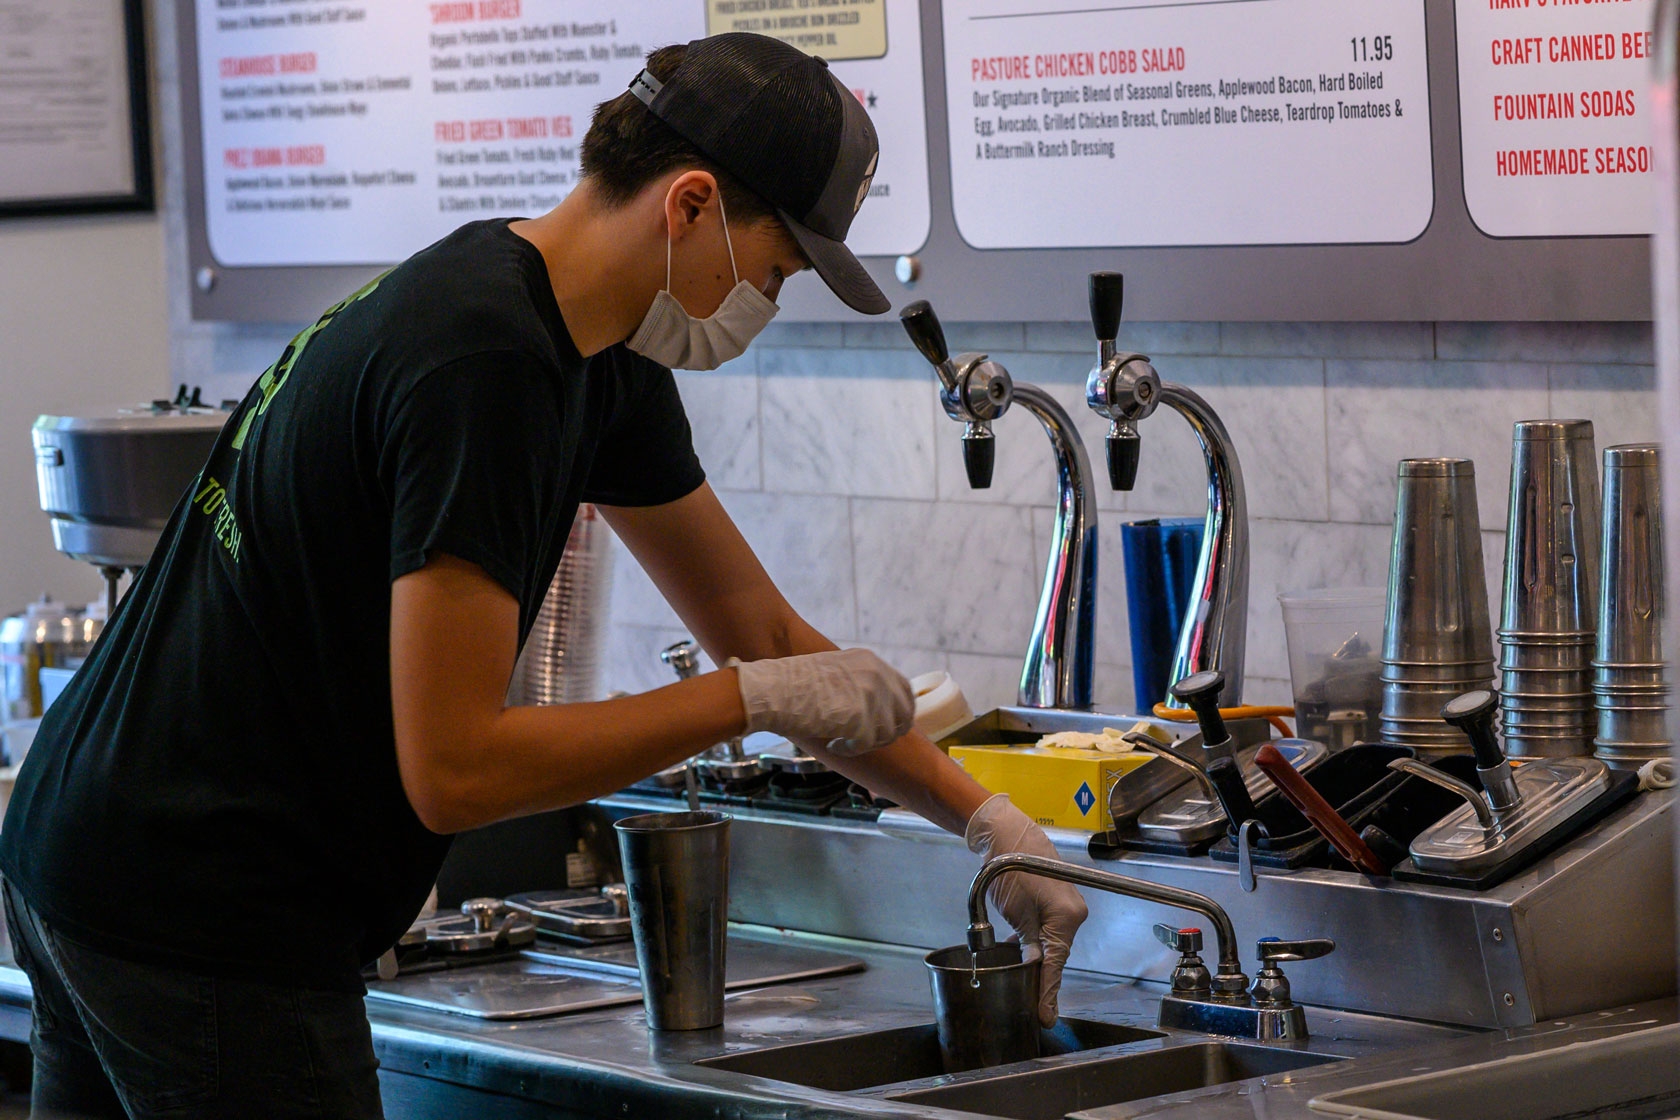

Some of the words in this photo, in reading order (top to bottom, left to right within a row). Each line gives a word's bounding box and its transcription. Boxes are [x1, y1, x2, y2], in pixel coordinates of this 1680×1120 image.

[972, 56, 1031, 81] PASTURE
[1034, 52, 1095, 79] CHICKEN
[1099, 50, 1137, 75] COBB
[1141, 46, 1186, 73] SALAD
[1351, 35, 1393, 62] 11.95
[1491, 37, 1543, 65] CRAFT
[1549, 33, 1616, 62] CANNED
[972, 90, 989, 108] Our
[992, 88, 1039, 110] Signature
[1041, 86, 1080, 107] Organic
[1082, 85, 1111, 103] Blend
[1113, 83, 1125, 101] of
[1126, 81, 1173, 100] Seasonal
[1175, 80, 1216, 99] Greens,
[1218, 77, 1275, 99] Applewood
[1278, 75, 1316, 95] Bacon,
[1319, 73, 1345, 92] Hard
[1348, 71, 1384, 90] Boiled
[1493, 92, 1575, 121] FOUNTAIN
[1580, 89, 1636, 118] SODAS
[974, 116, 995, 137] Egg,
[998, 115, 1041, 132] Avocado,
[1043, 113, 1076, 132] Grilled
[1079, 111, 1120, 130] Chicken
[1121, 109, 1158, 129] Breast,
[1161, 107, 1212, 127] Crumbled
[1213, 105, 1238, 124] Blue
[1240, 104, 1283, 124] Cheese,
[1286, 101, 1336, 124] Teardrop
[1337, 101, 1391, 119] Tomatoes
[1395, 99, 1404, 117] &
[976, 143, 983, 159] A
[984, 141, 1036, 159] Buttermilk
[1038, 140, 1070, 157] Ranch
[1071, 138, 1116, 159] Dressing
[1496, 148, 1591, 176] HOMEMADE
[193, 477, 226, 515] TO
[1081, 791, 1089, 806] M
